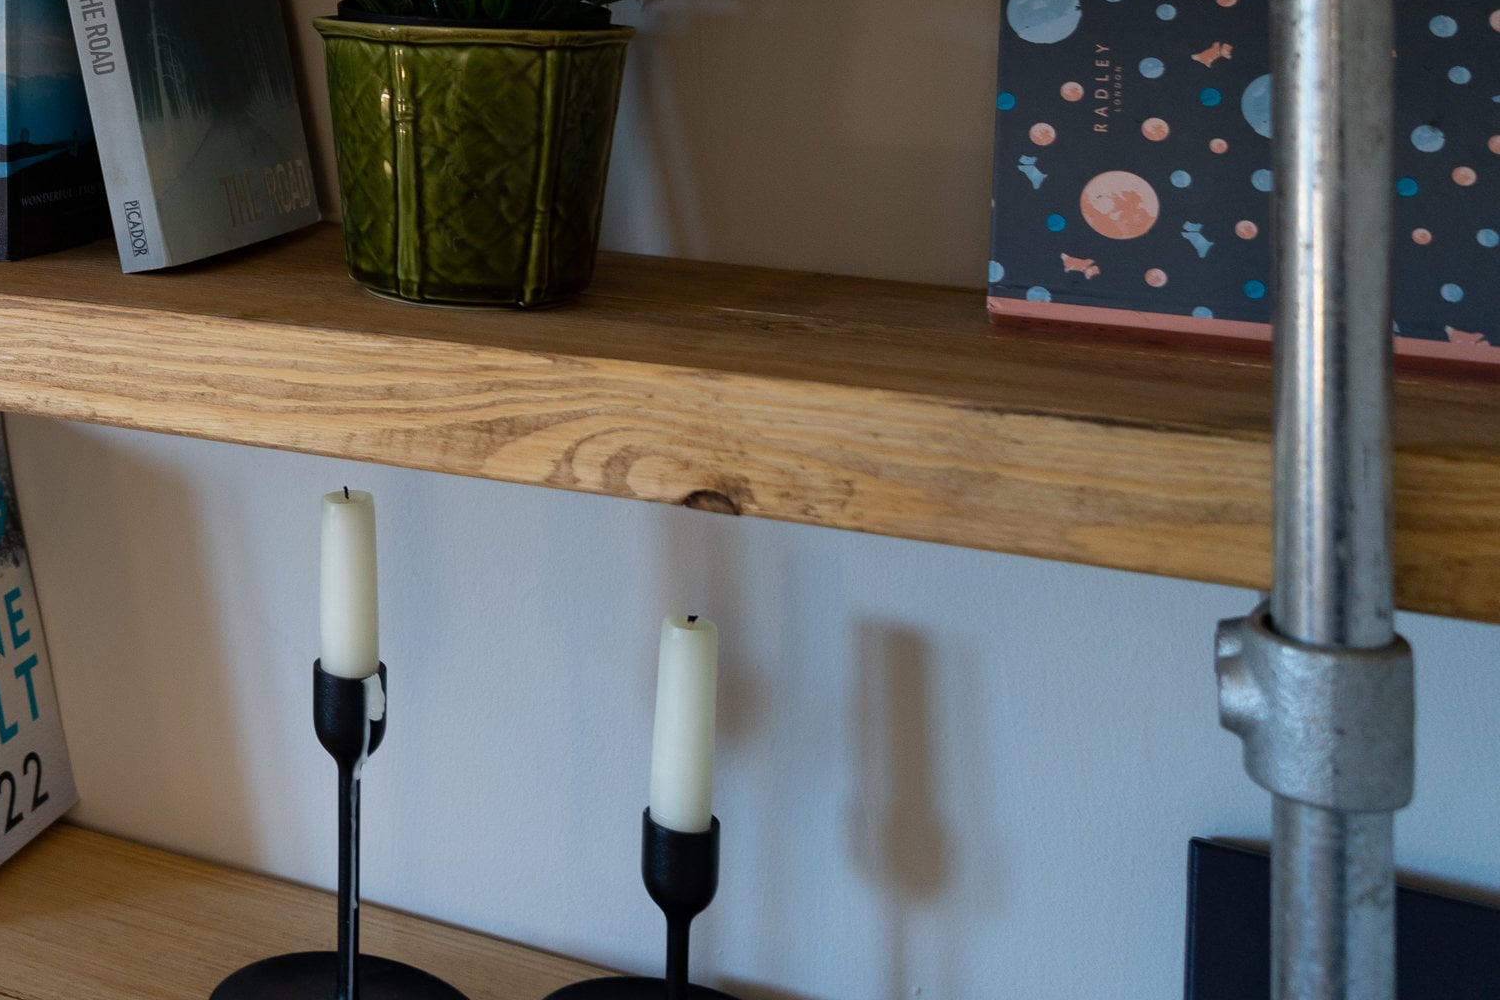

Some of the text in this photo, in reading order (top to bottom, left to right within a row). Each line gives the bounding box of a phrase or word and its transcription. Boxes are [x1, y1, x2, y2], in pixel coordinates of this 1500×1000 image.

[83, 24, 115, 76] ROAD
[1093, 41, 1109, 134] RADLEY
[1114, 65, 1123, 112] LONDON
[219, 159, 311, 229] THE ROAD
[123, 199, 148, 258] PICADOR
